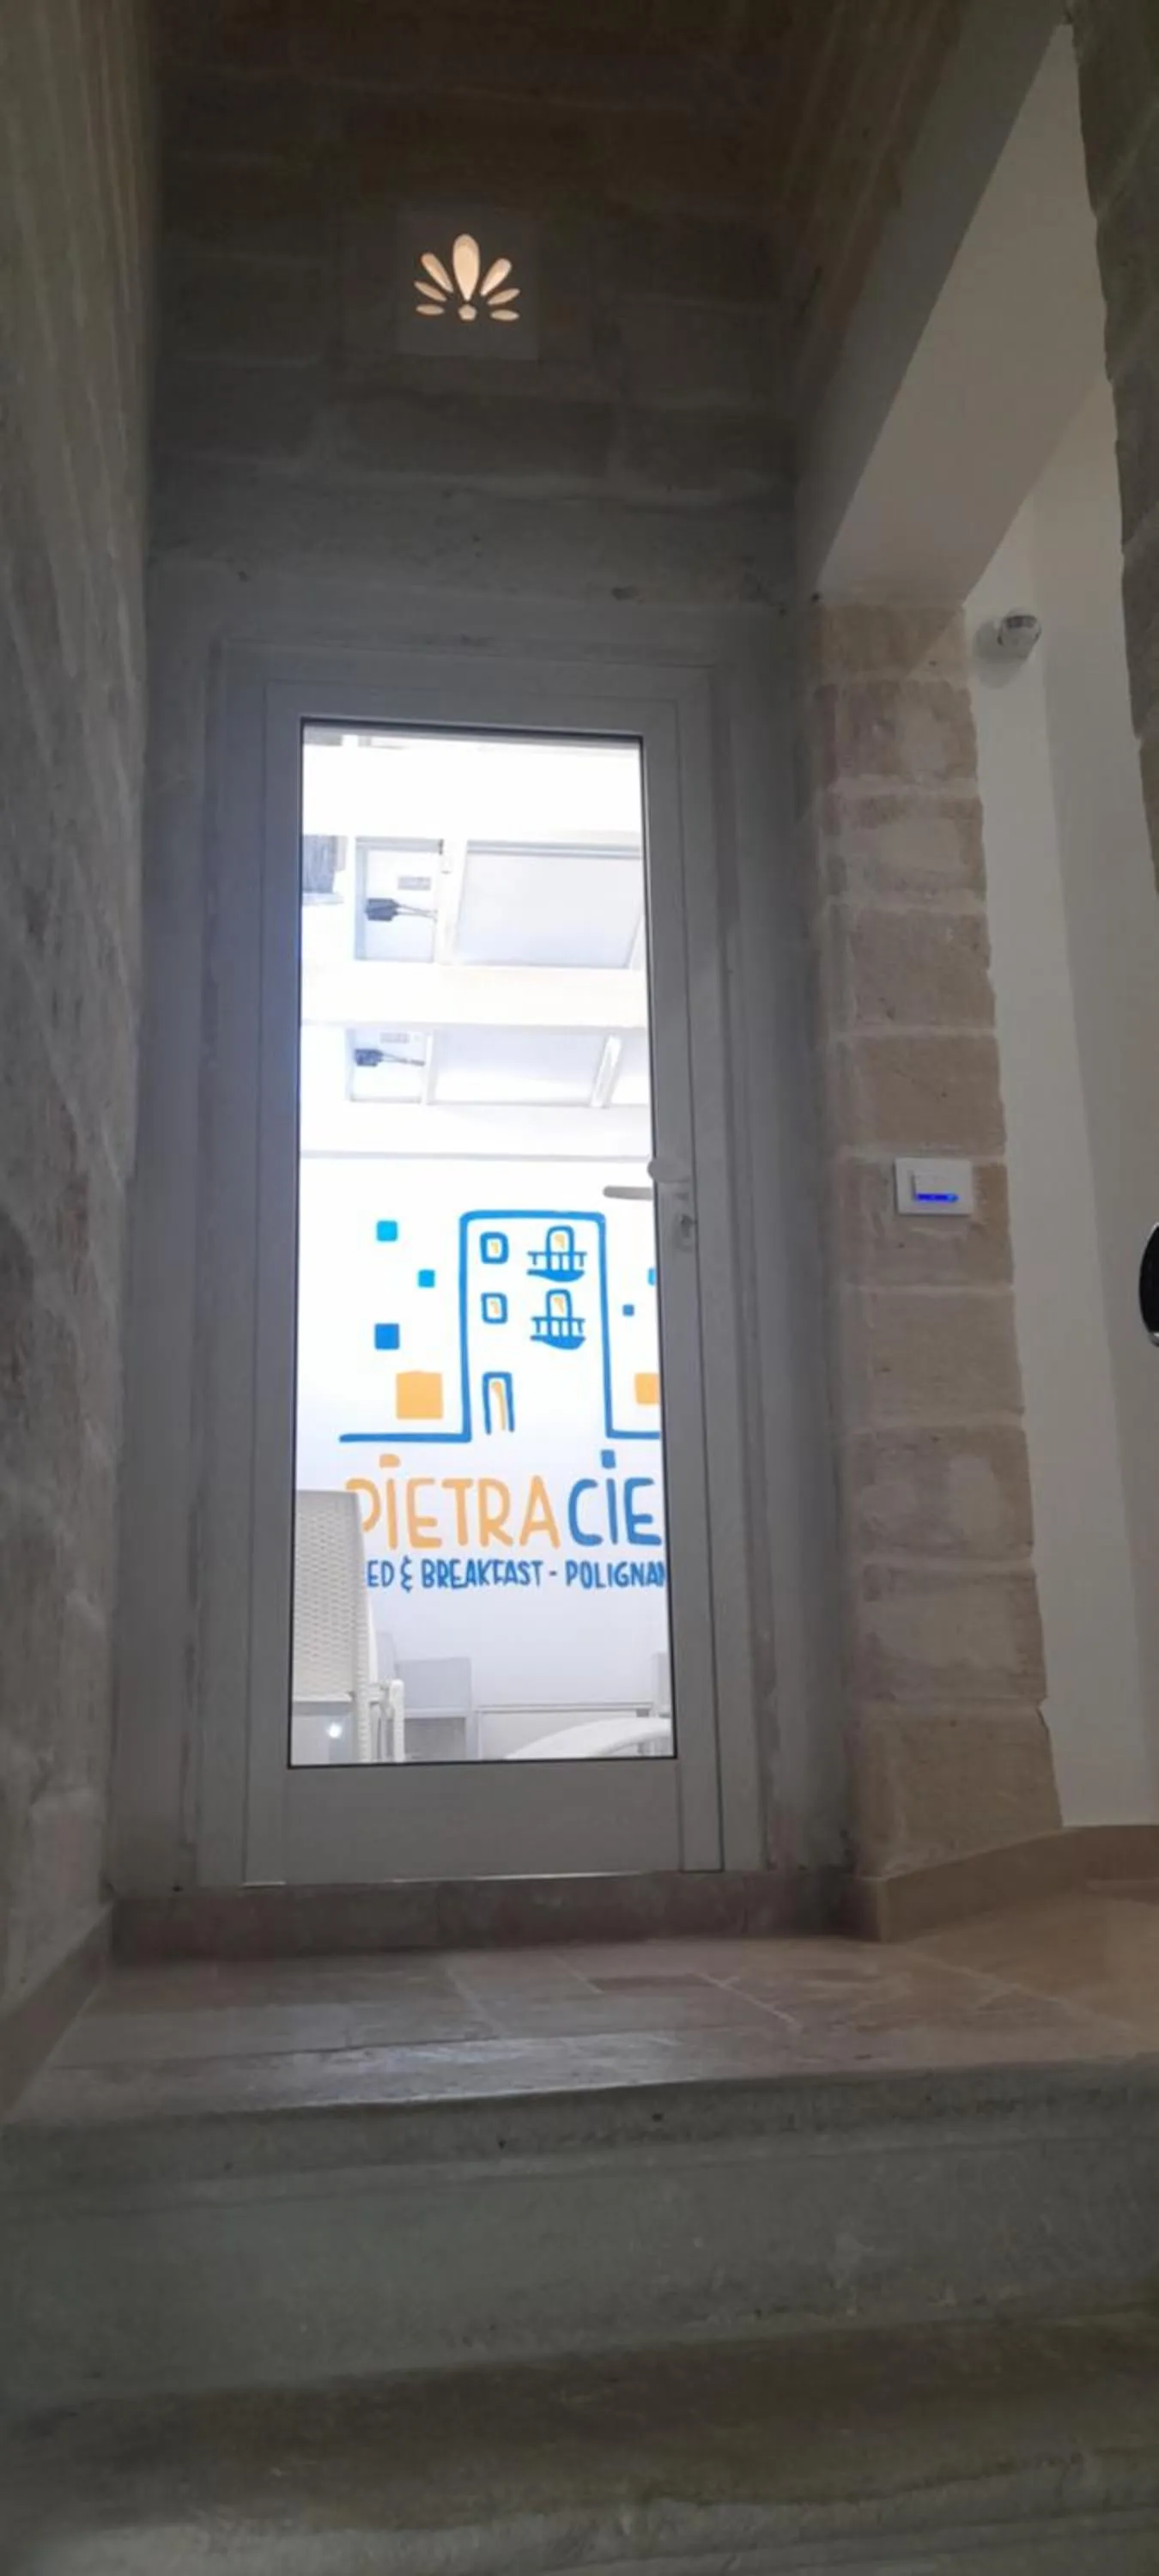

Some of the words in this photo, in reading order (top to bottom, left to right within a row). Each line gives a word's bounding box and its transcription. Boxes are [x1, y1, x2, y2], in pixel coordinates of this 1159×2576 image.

[345, 1449, 662, 1550] PIETRACIE
[367, 1559, 395, 1588] ED
[400, 1555, 412, 1592] &
[422, 1558, 543, 1589] BREAKFAST
